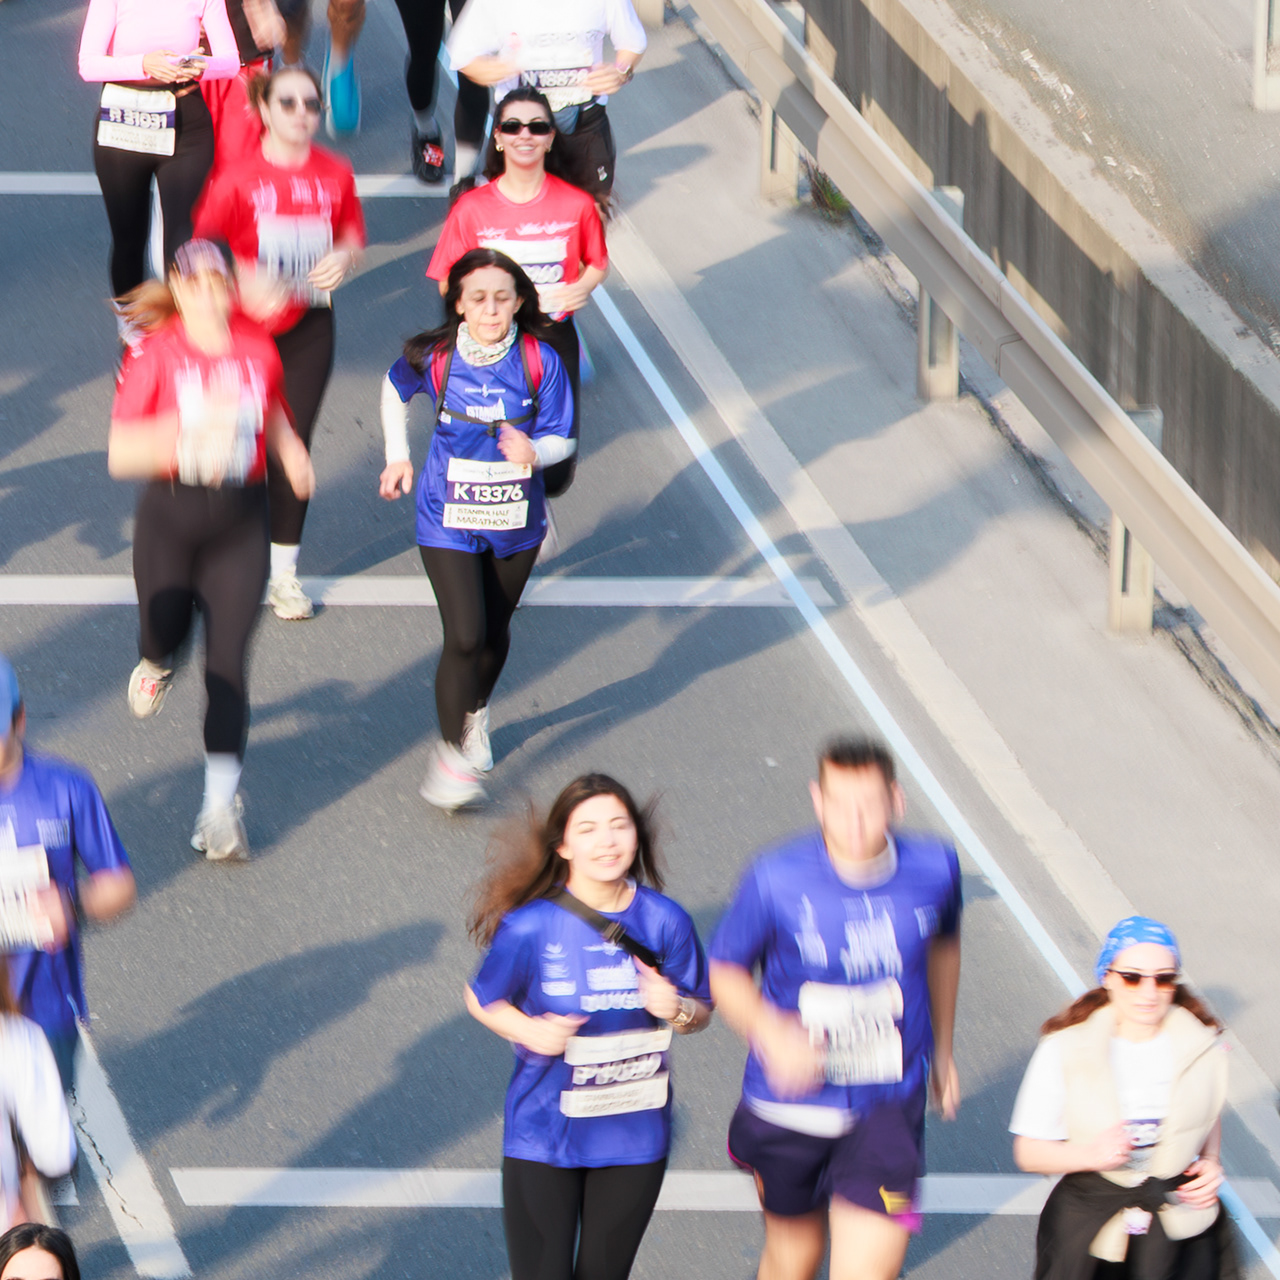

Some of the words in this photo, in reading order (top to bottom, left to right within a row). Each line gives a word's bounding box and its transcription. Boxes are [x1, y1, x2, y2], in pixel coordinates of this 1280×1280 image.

[454, 483, 470, 500] K
[471, 483, 524, 503] 13376
[456, 515, 510, 527] MARATHON
